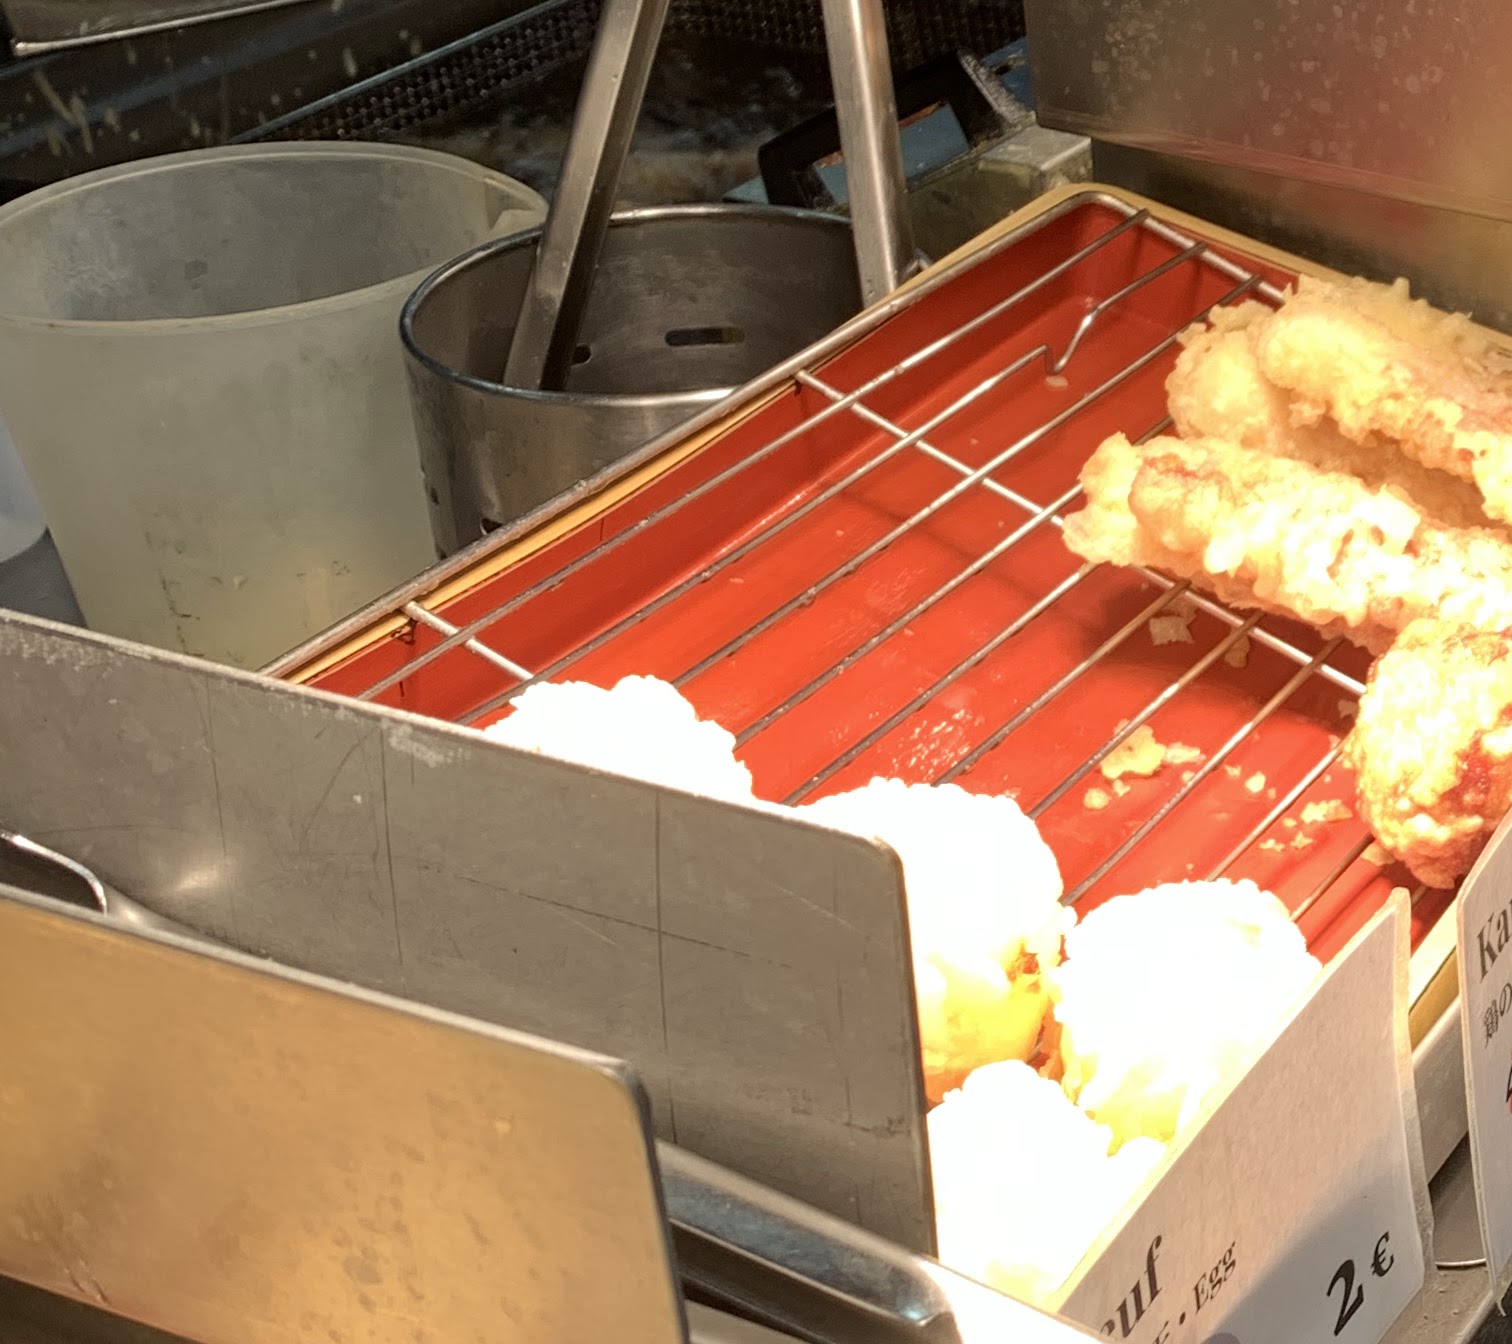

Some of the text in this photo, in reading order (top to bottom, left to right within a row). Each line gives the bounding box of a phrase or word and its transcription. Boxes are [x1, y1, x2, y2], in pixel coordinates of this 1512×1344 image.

[1191, 1240, 1237, 1316] Egg
[1326, 1230, 1396, 1337] 2 €
